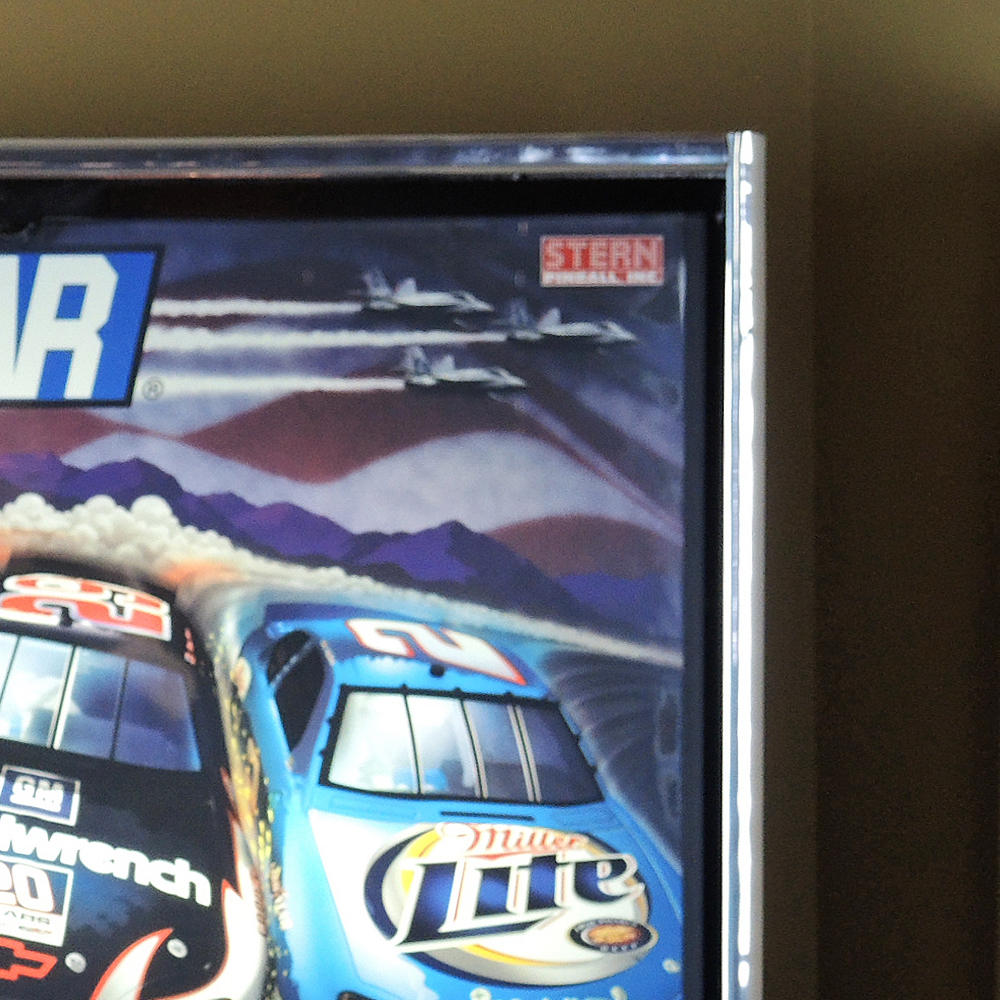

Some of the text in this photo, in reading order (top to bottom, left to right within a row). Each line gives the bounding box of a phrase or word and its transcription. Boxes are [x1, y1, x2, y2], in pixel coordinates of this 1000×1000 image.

[543, 238, 660, 269] STERN
[10, 776, 64, 811] GM
[435, 823, 590, 853] Miller
